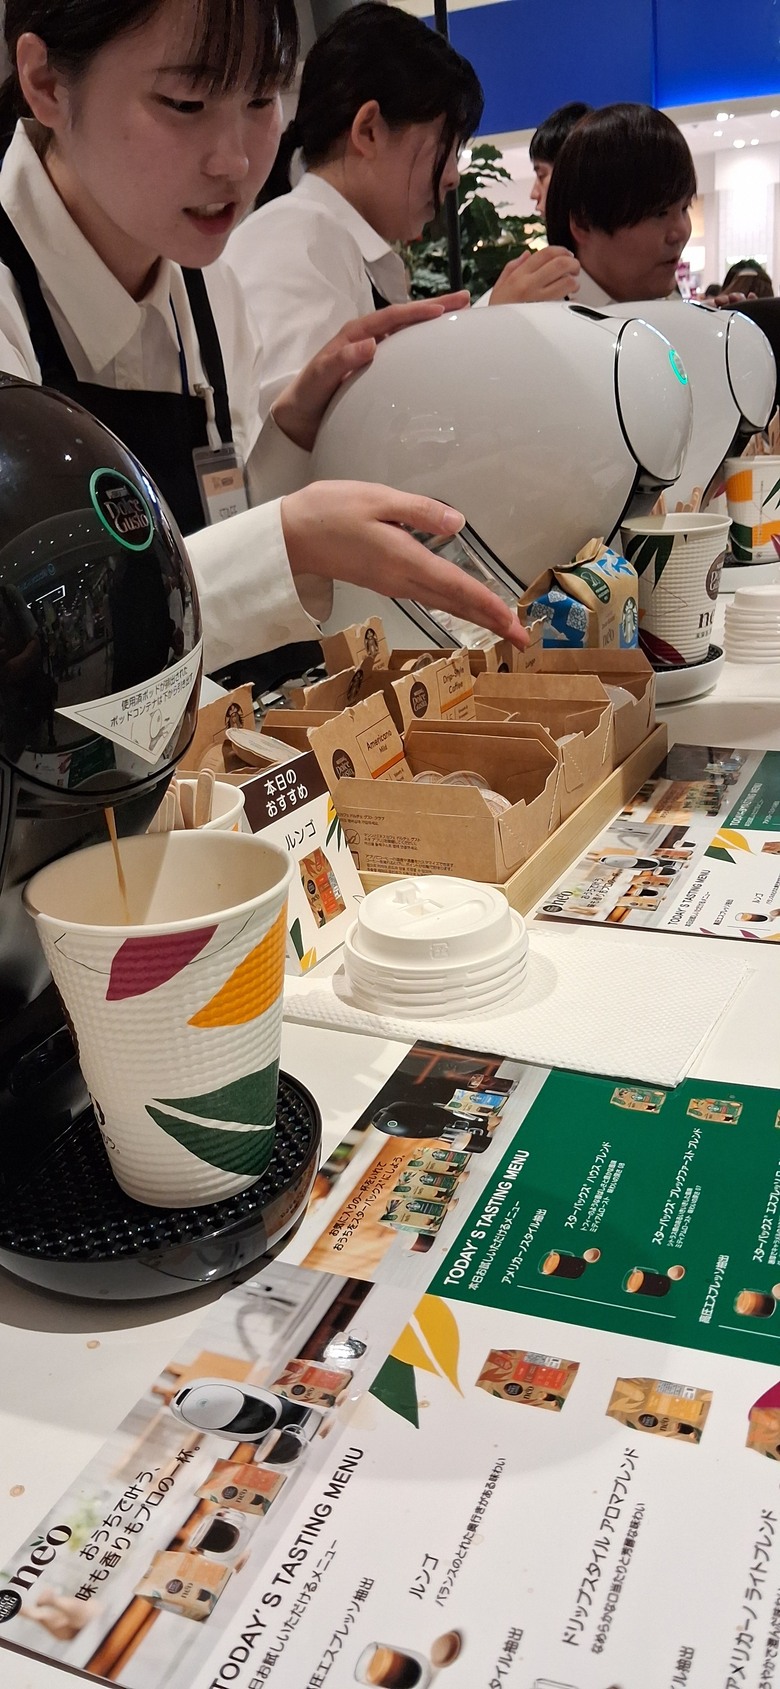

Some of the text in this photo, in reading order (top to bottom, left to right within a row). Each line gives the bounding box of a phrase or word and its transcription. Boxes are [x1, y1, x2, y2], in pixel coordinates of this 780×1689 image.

[103, 499, 143, 520] Dolce
[114, 514, 149, 534] Gusto
[366, 729, 393, 752] Americano
[263, 768, 298, 797] 本日の
[265, 783, 310, 818] おすすめ
[284, 818, 317, 851] ルンゴ
[695, 869, 711, 884] MENU
[329, 1160, 388, 1237] お気に入りの一杯をいれて
[478, 1181, 513, 1230] TASTING
[506, 1149, 530, 1188] MENU
[75, 1445, 201, 1602] 味も香りもプロの一杯。
[271, 1502, 333, 1589] TASTING
[323, 1446, 365, 1499] MENU
[435, 1457, 507, 1607] バランスのとれた奥行きがある味わい
[408, 1552, 440, 1600] ルンゴ
